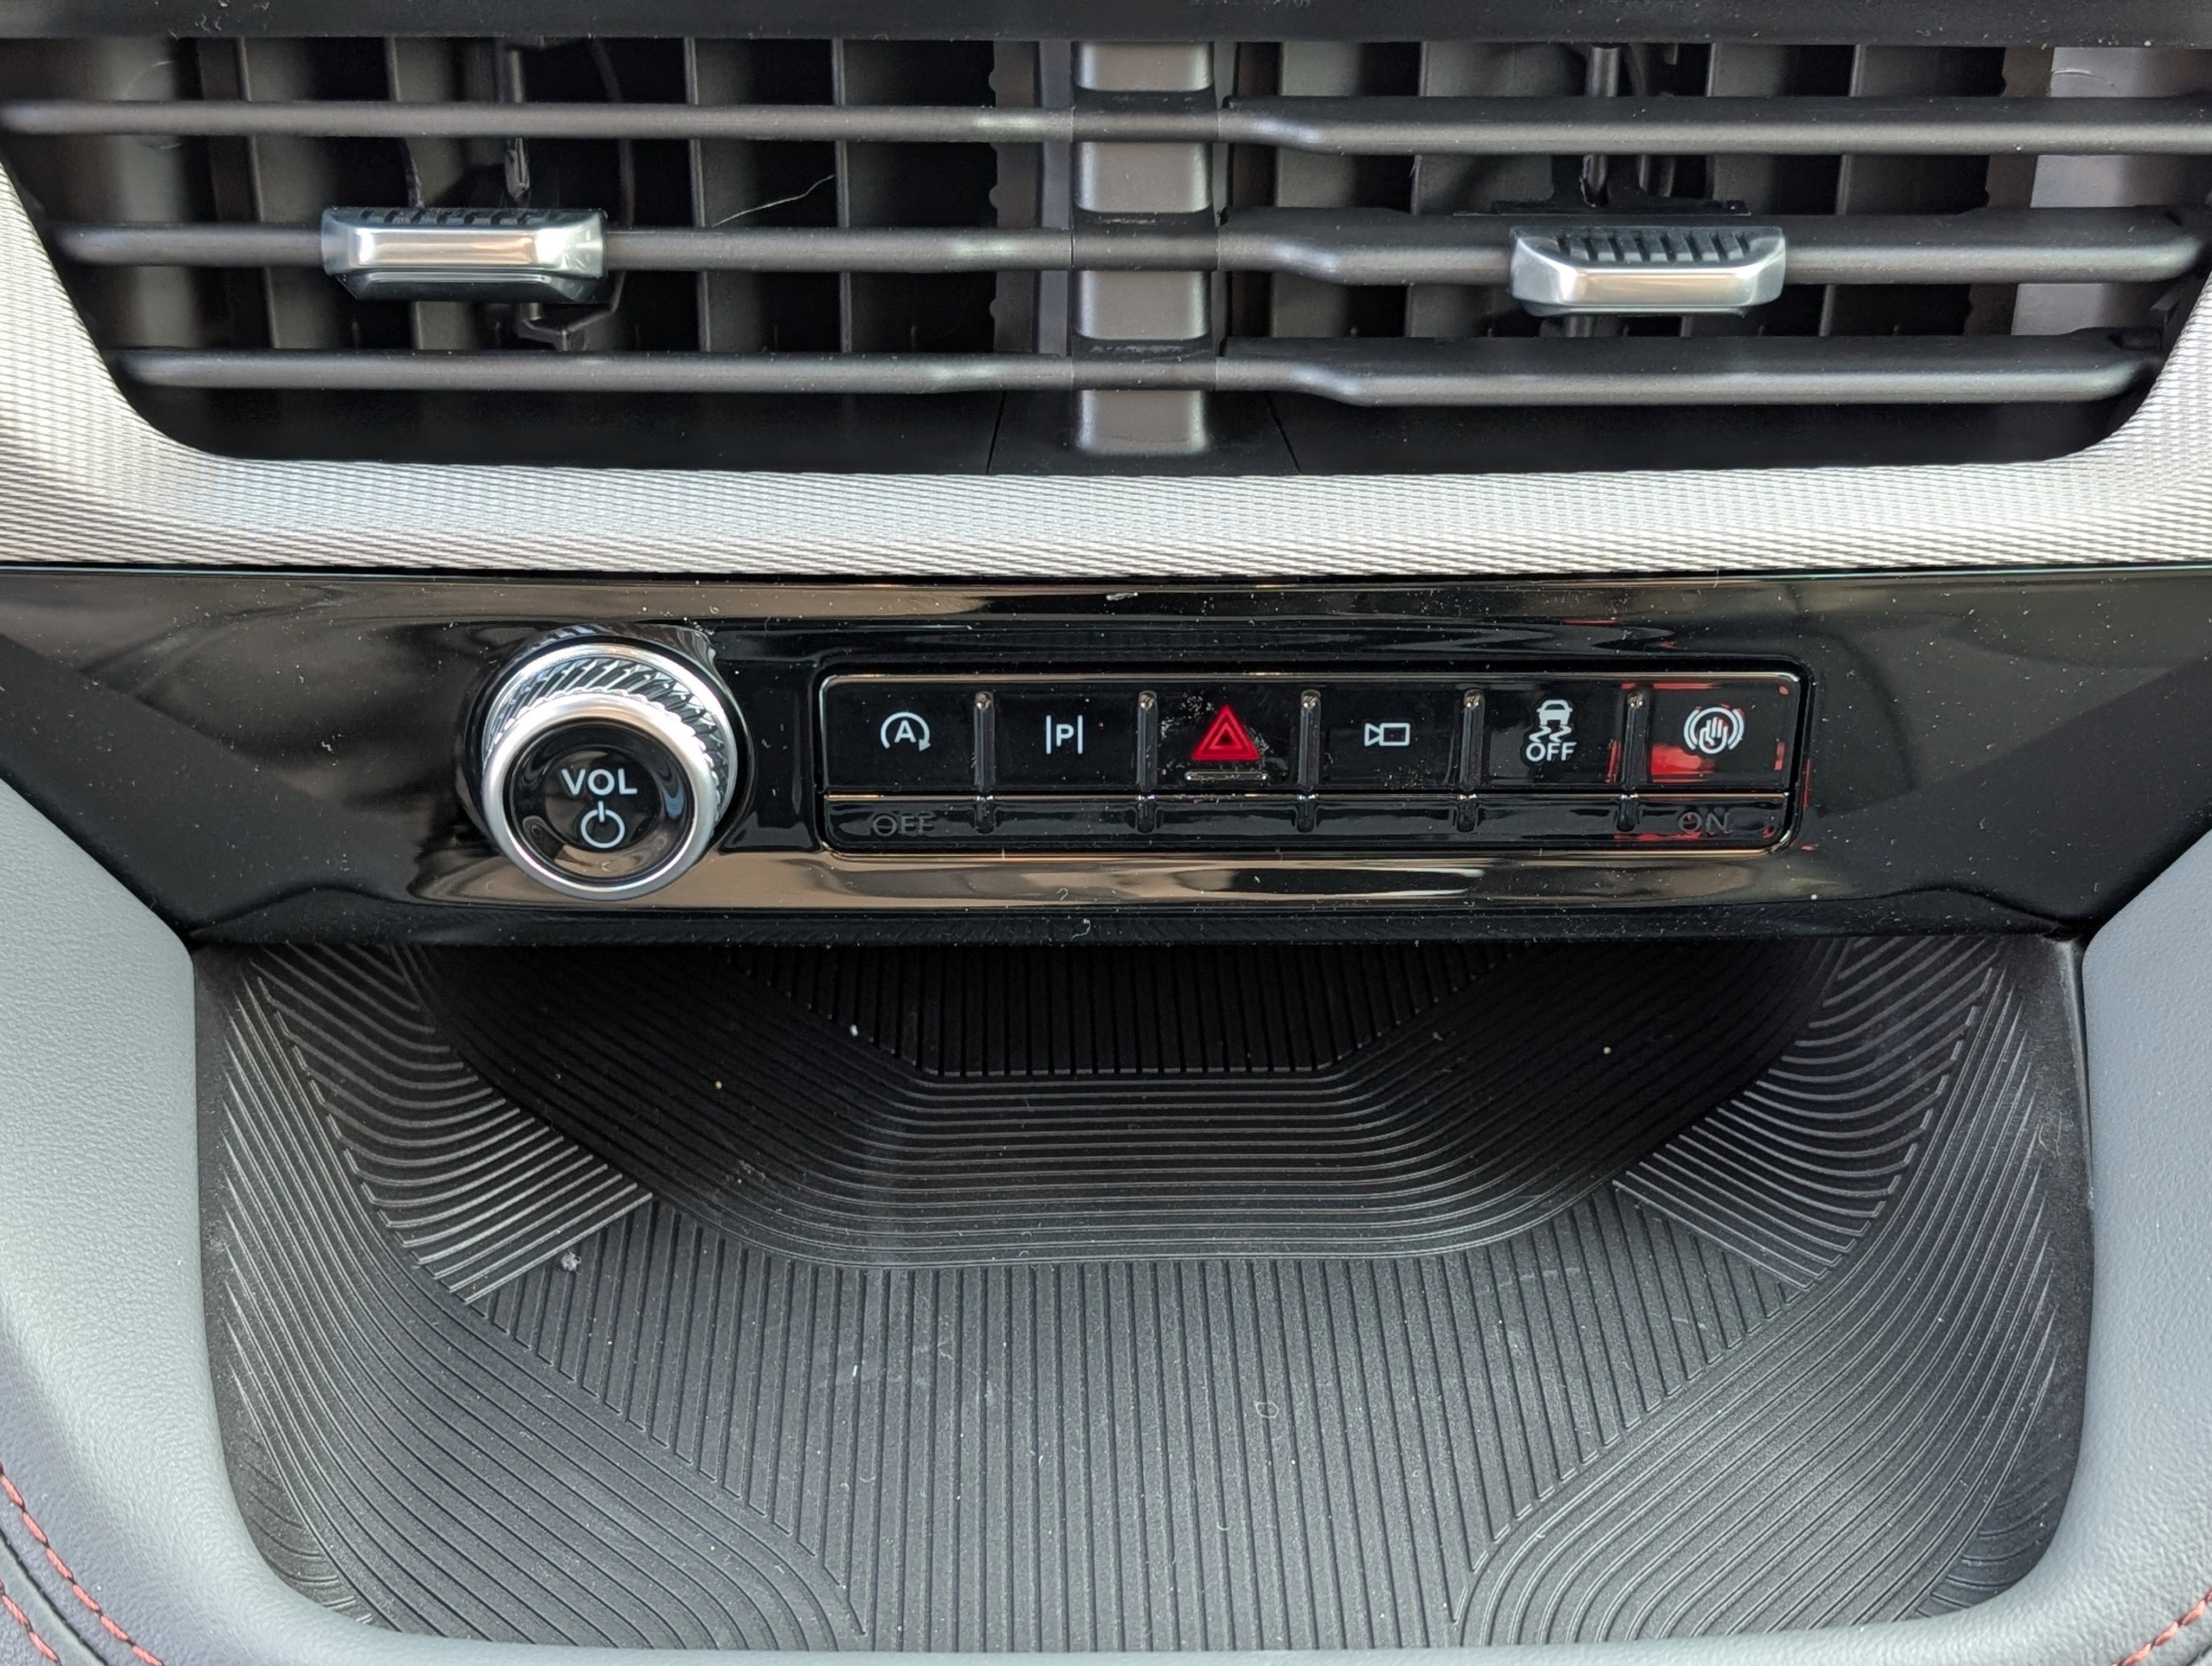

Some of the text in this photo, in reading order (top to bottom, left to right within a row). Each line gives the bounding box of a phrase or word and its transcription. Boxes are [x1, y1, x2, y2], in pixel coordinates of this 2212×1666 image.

[894, 720, 916, 742] A
[1056, 724, 1075, 747] P
[1525, 742, 1577, 762] OFF
[561, 768, 638, 796] VOL
[873, 815, 933, 836] OFF
[1679, 811, 1729, 833] ON
